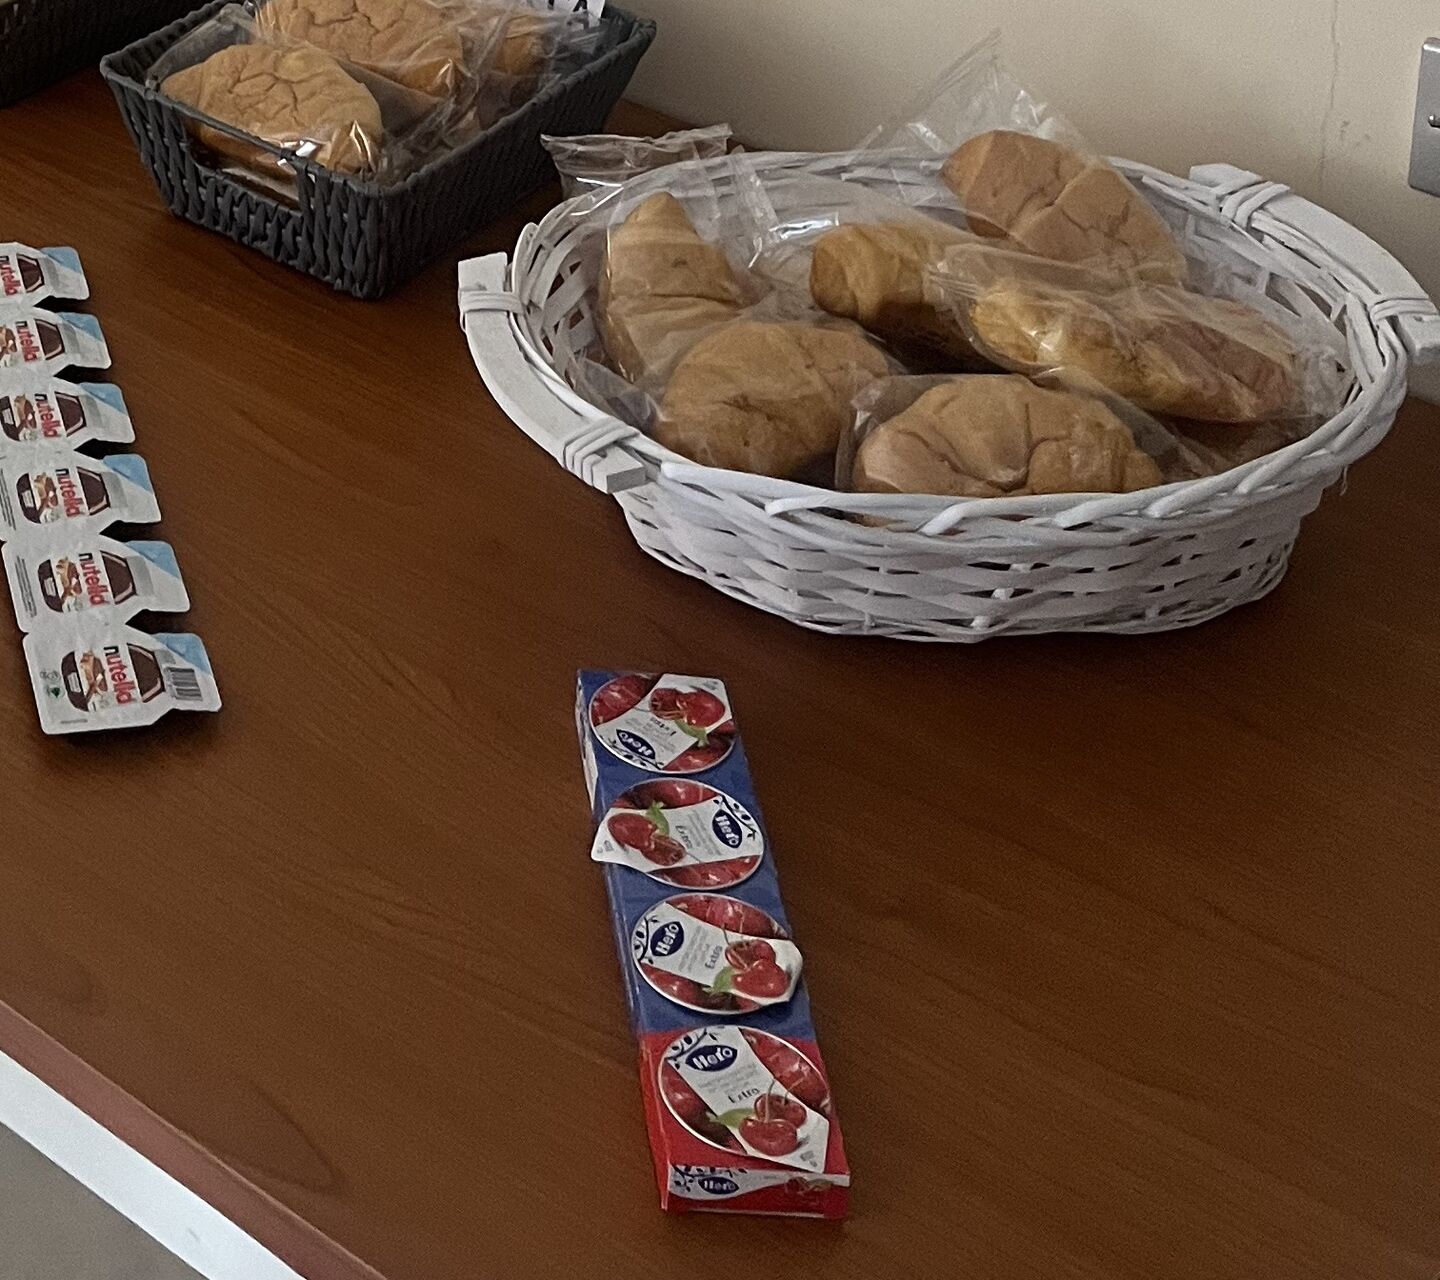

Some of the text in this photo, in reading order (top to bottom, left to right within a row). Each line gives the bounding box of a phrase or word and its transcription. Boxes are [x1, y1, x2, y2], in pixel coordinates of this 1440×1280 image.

[15, 320, 41, 363] nutella
[34, 393, 62, 438] nutella
[55, 468, 85, 518] nutella
[78, 552, 111, 609] nutella
[103, 645, 138, 706] nutella
[618, 730, 654, 758] Hero
[715, 814, 740, 847] Hero
[655, 923, 680, 956] Hero
[691, 1045, 735, 1071] Hero
